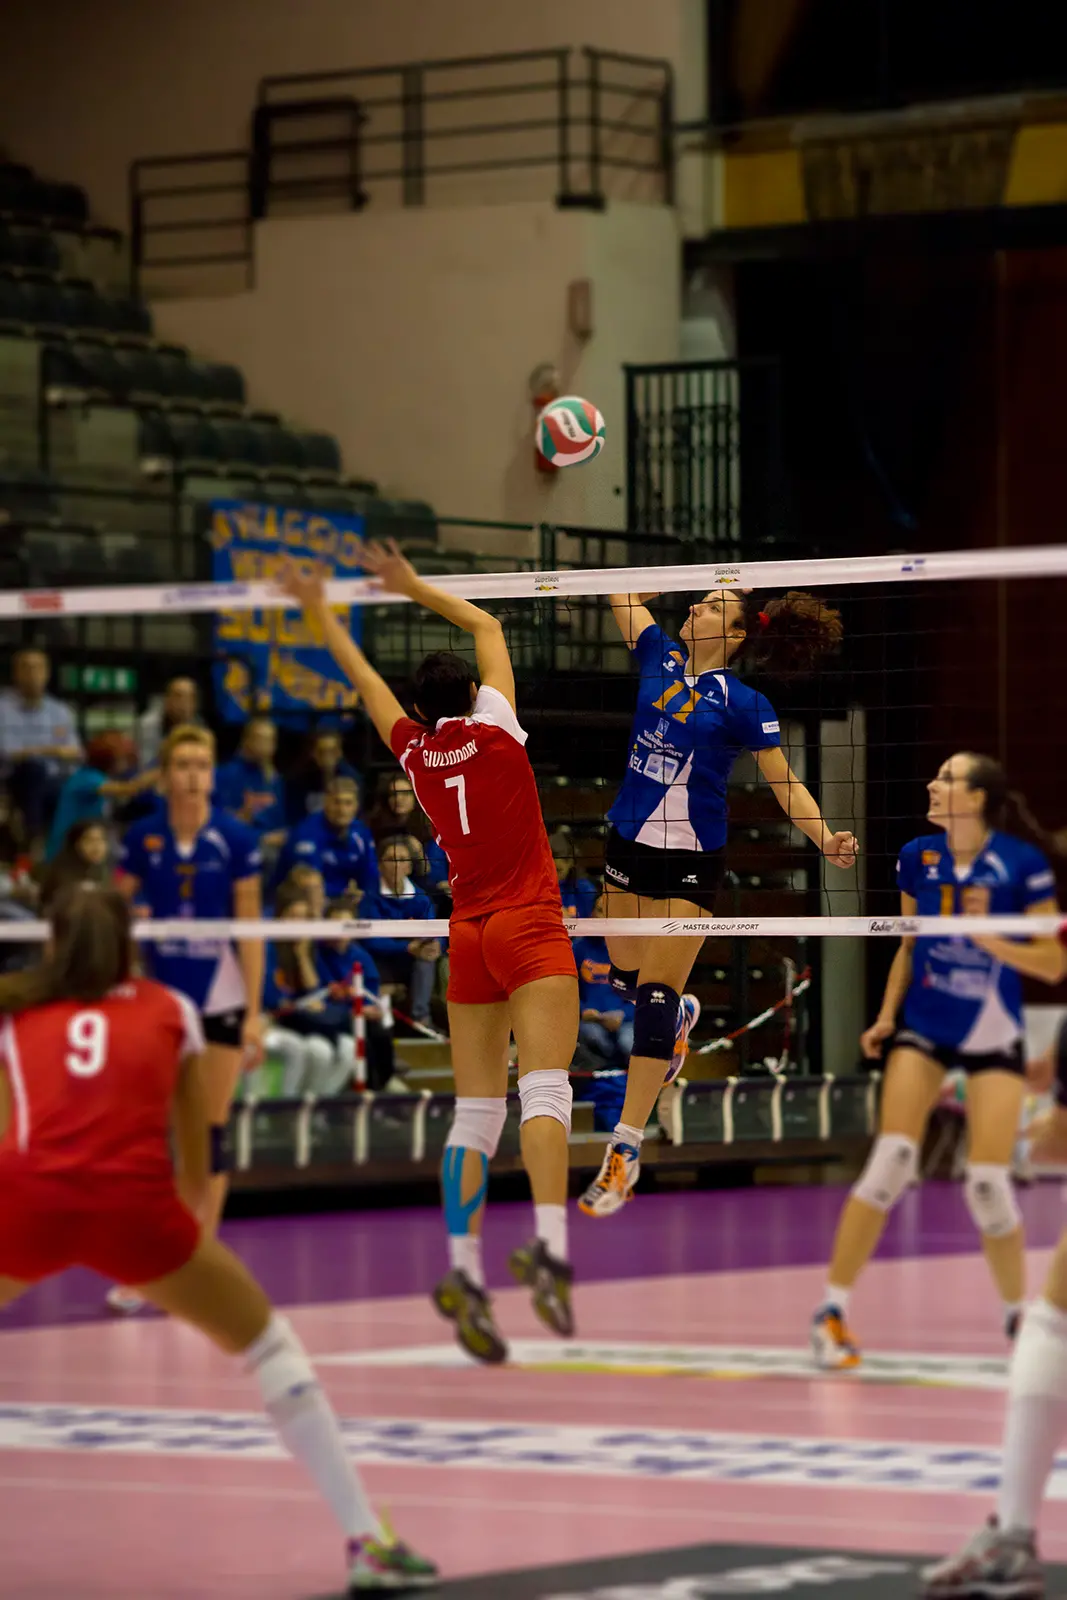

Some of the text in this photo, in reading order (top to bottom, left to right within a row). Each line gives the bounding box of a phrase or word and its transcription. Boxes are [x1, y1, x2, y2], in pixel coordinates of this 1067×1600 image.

[422, 739, 478, 767] GIULIODORI
[444, 774, 471, 835] 7
[682, 923, 760, 931] MASTER GROUP SPORT
[66, 1010, 109, 1076] 9
